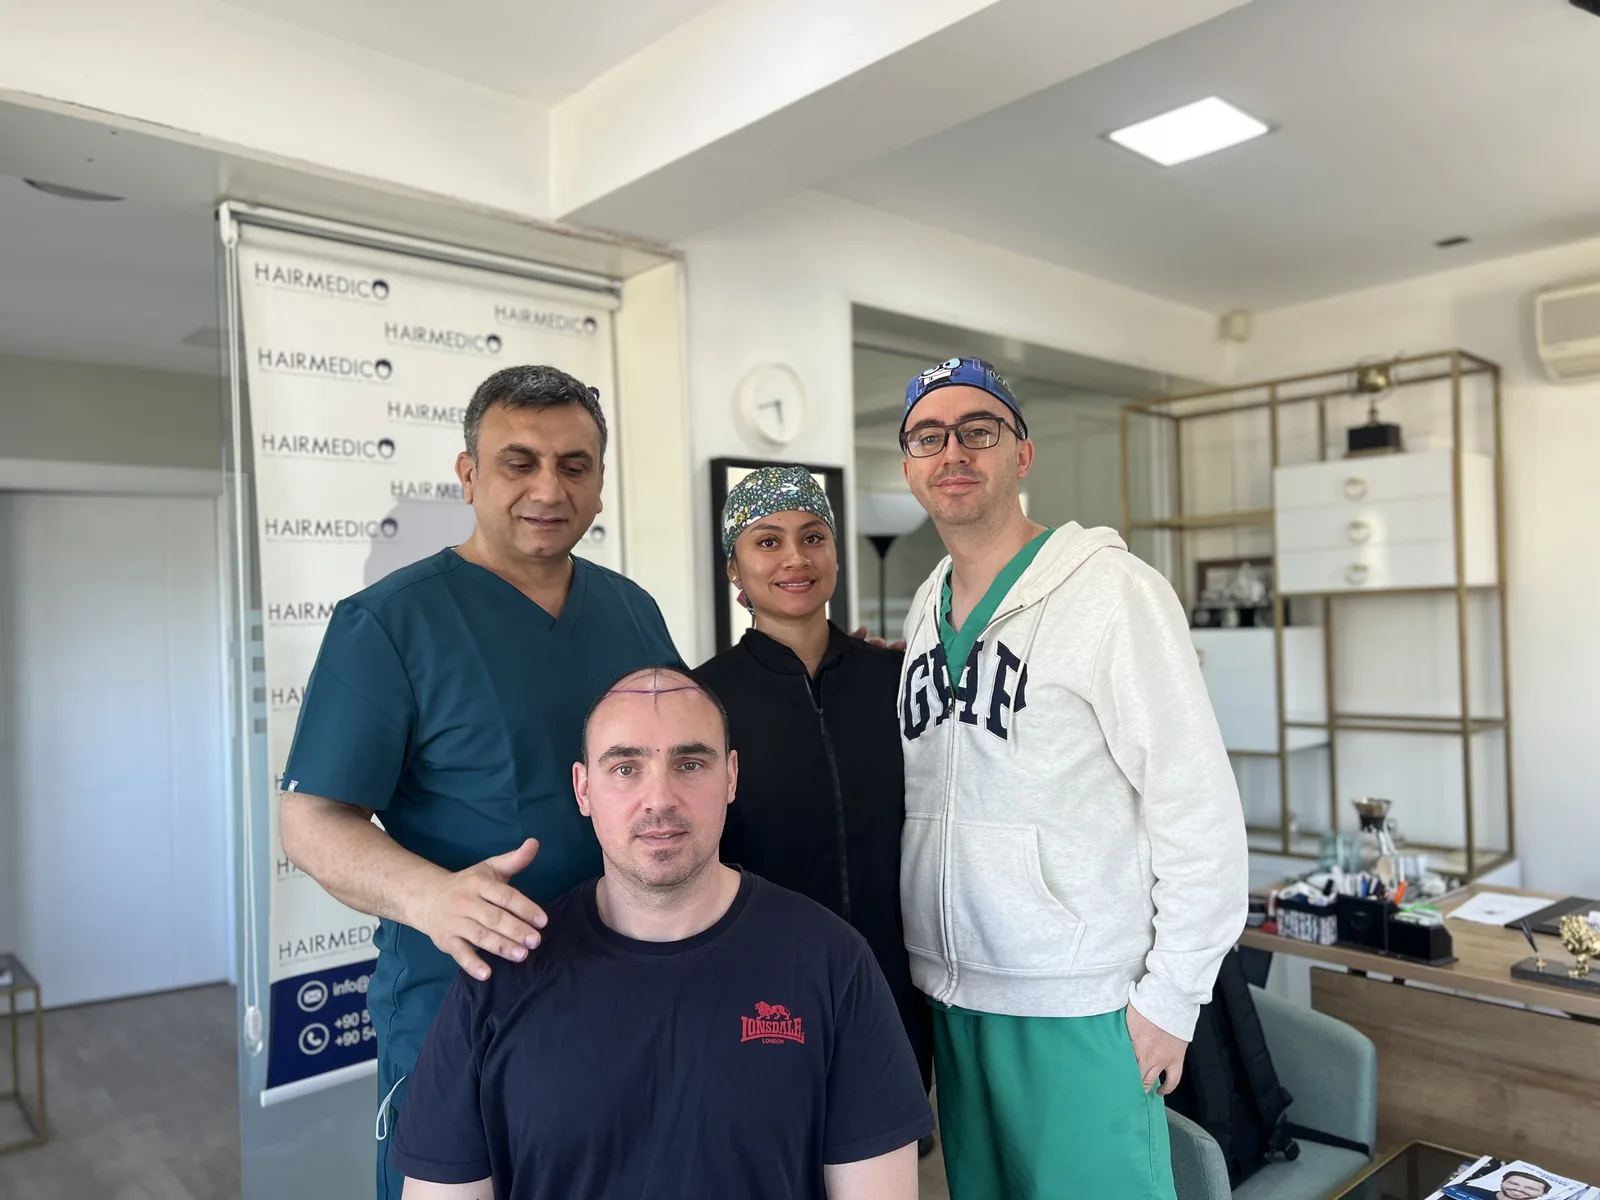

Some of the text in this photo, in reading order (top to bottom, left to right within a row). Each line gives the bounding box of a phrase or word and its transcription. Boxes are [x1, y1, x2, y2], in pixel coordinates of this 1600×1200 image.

[254, 262, 390, 301] HAIRMEDICO
[494, 304, 597, 336] HAIRMEDICO
[384, 321, 502, 355] HAIRMEDICO
[258, 348, 392, 380] HAIRMEDICO
[387, 401, 467, 424] HAIRMED
[261, 433, 395, 459] HAIRMEDICO
[390, 480, 464, 500] HAIRME
[264, 516, 398, 539] HAIRMEDICO
[268, 602, 334, 620] HAIRM
[279, 924, 377, 961] HAIRMED
[333, 975, 370, 996] info@
[334, 1011, 360, 1029] +90
[741, 1015, 805, 1045] LONSDALE
[334, 1029, 360, 1047] +90
